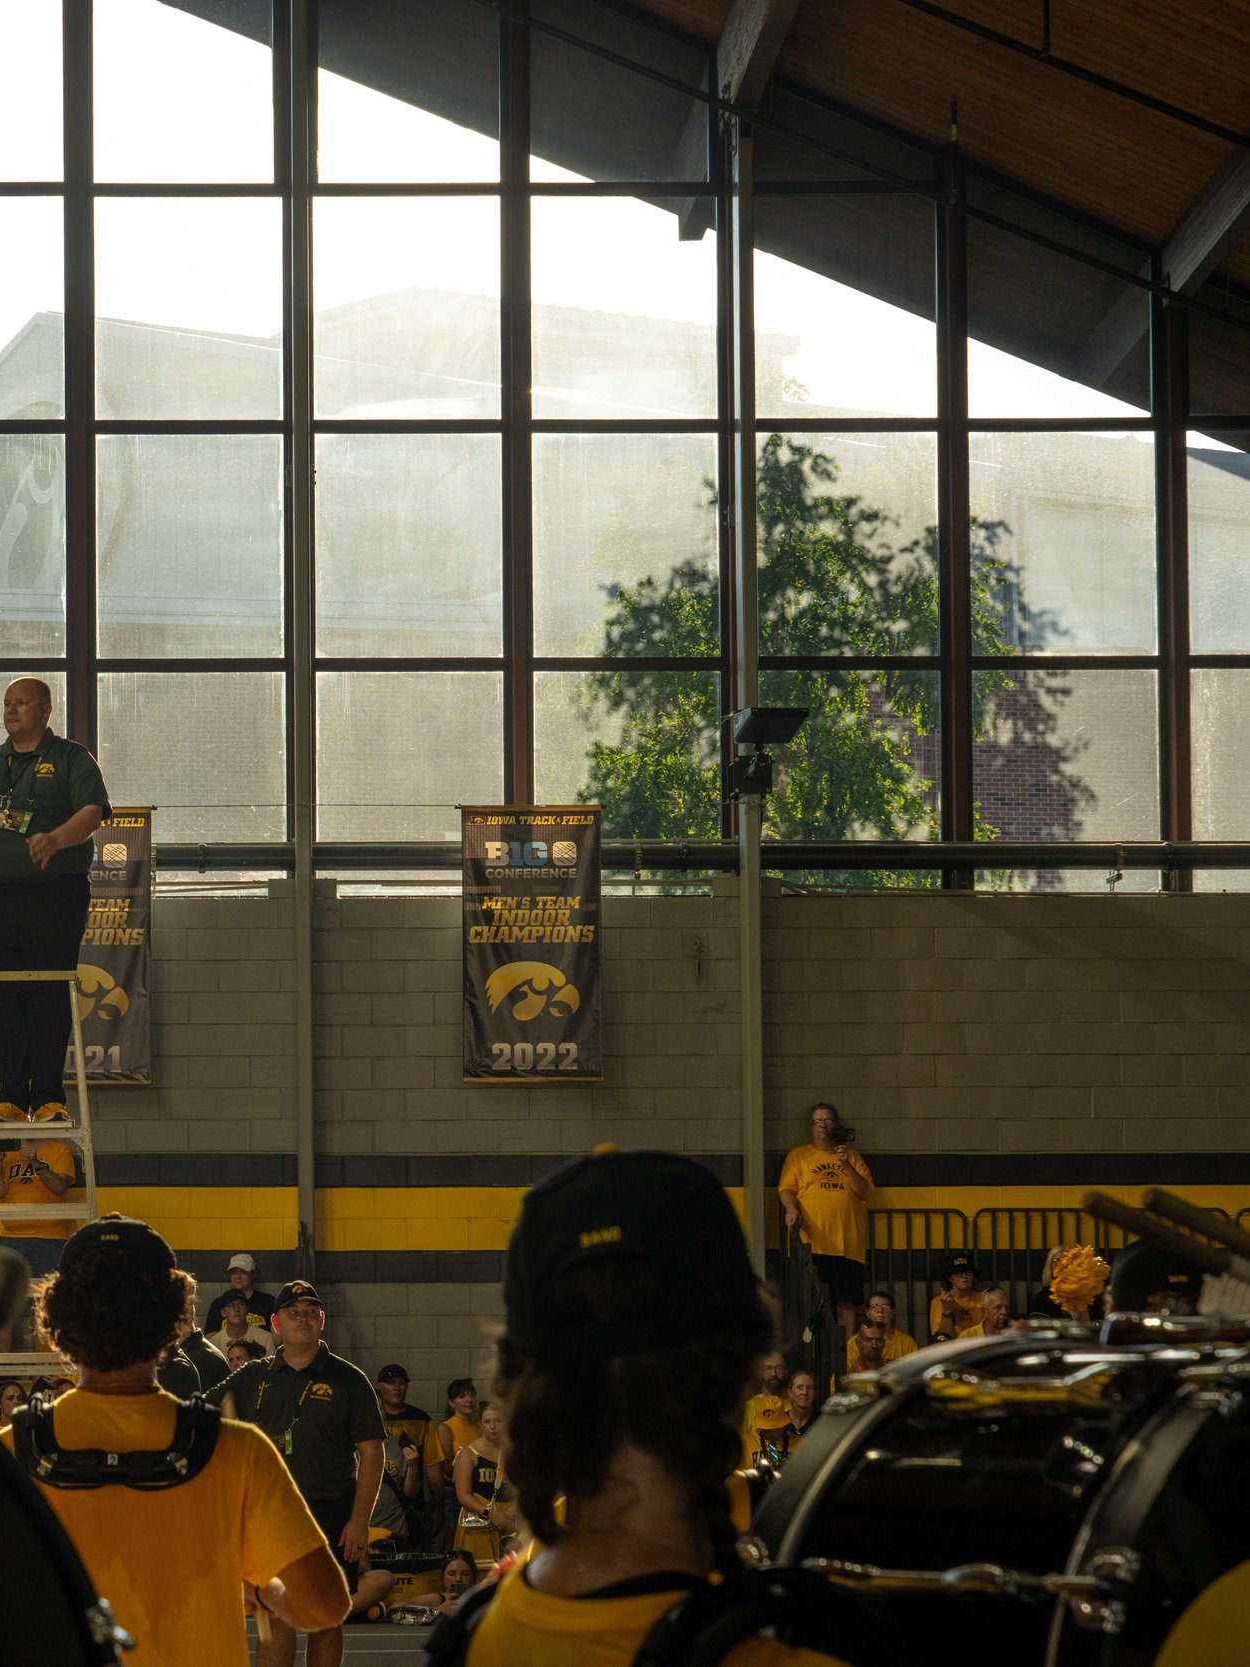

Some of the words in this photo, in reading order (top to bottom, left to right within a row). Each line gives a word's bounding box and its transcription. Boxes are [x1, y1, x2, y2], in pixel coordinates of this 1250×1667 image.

[112, 817, 145, 828] FIELD
[487, 815, 517, 825] IOWA
[519, 815, 556, 825] TRACK
[562, 815, 594, 825] FIELD
[485, 868, 577, 879] CONFERENCE
[482, 896, 531, 910] MEN'S
[535, 896, 581, 909] TEAM
[492, 909, 571, 926] INDOOR
[468, 925, 595, 944] CHAMPIONS
[492, 1042, 578, 1070] 2022
[820, 1182, 844, 1191] IOWA
